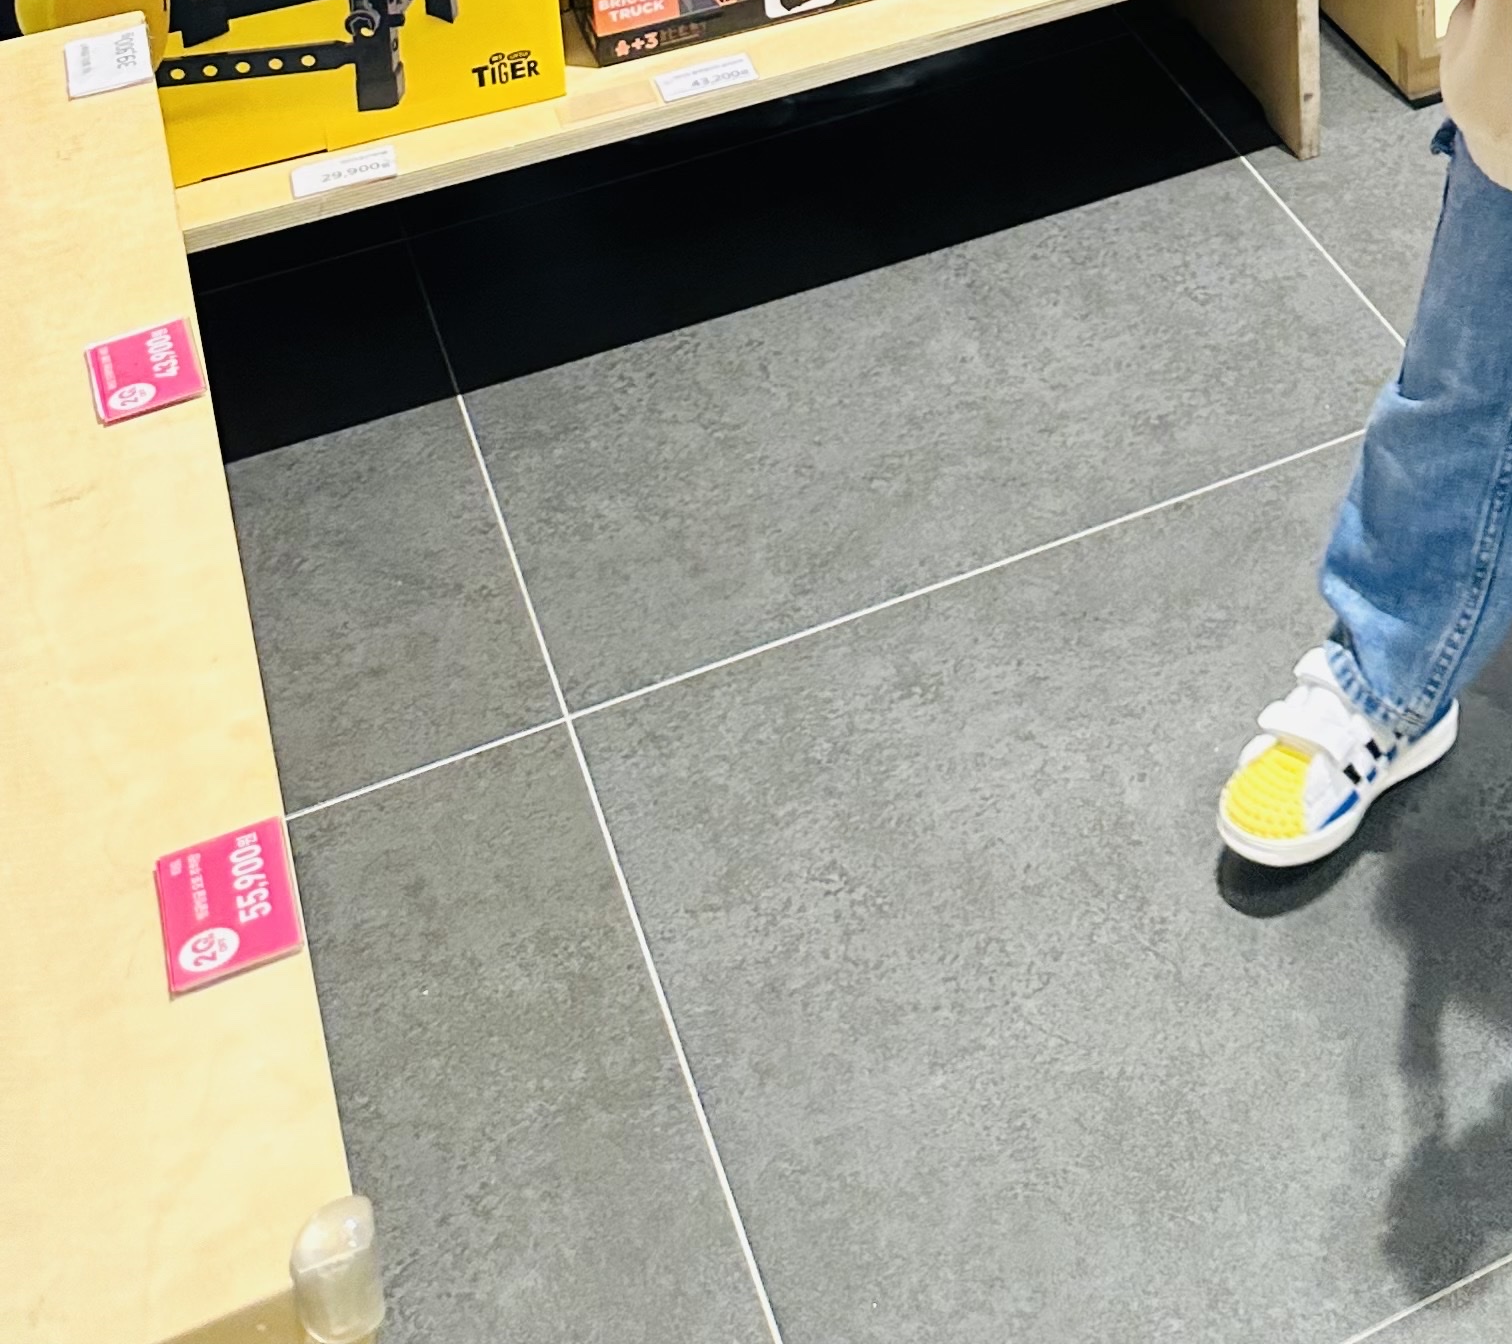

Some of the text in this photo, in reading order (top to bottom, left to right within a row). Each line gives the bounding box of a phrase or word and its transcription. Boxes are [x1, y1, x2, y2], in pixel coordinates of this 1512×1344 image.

[632, 30, 661, 50] +3
[472, 55, 541, 89] TIGER
[321, 160, 391, 182] 29,900원
[229, 831, 273, 924] 55,900원
